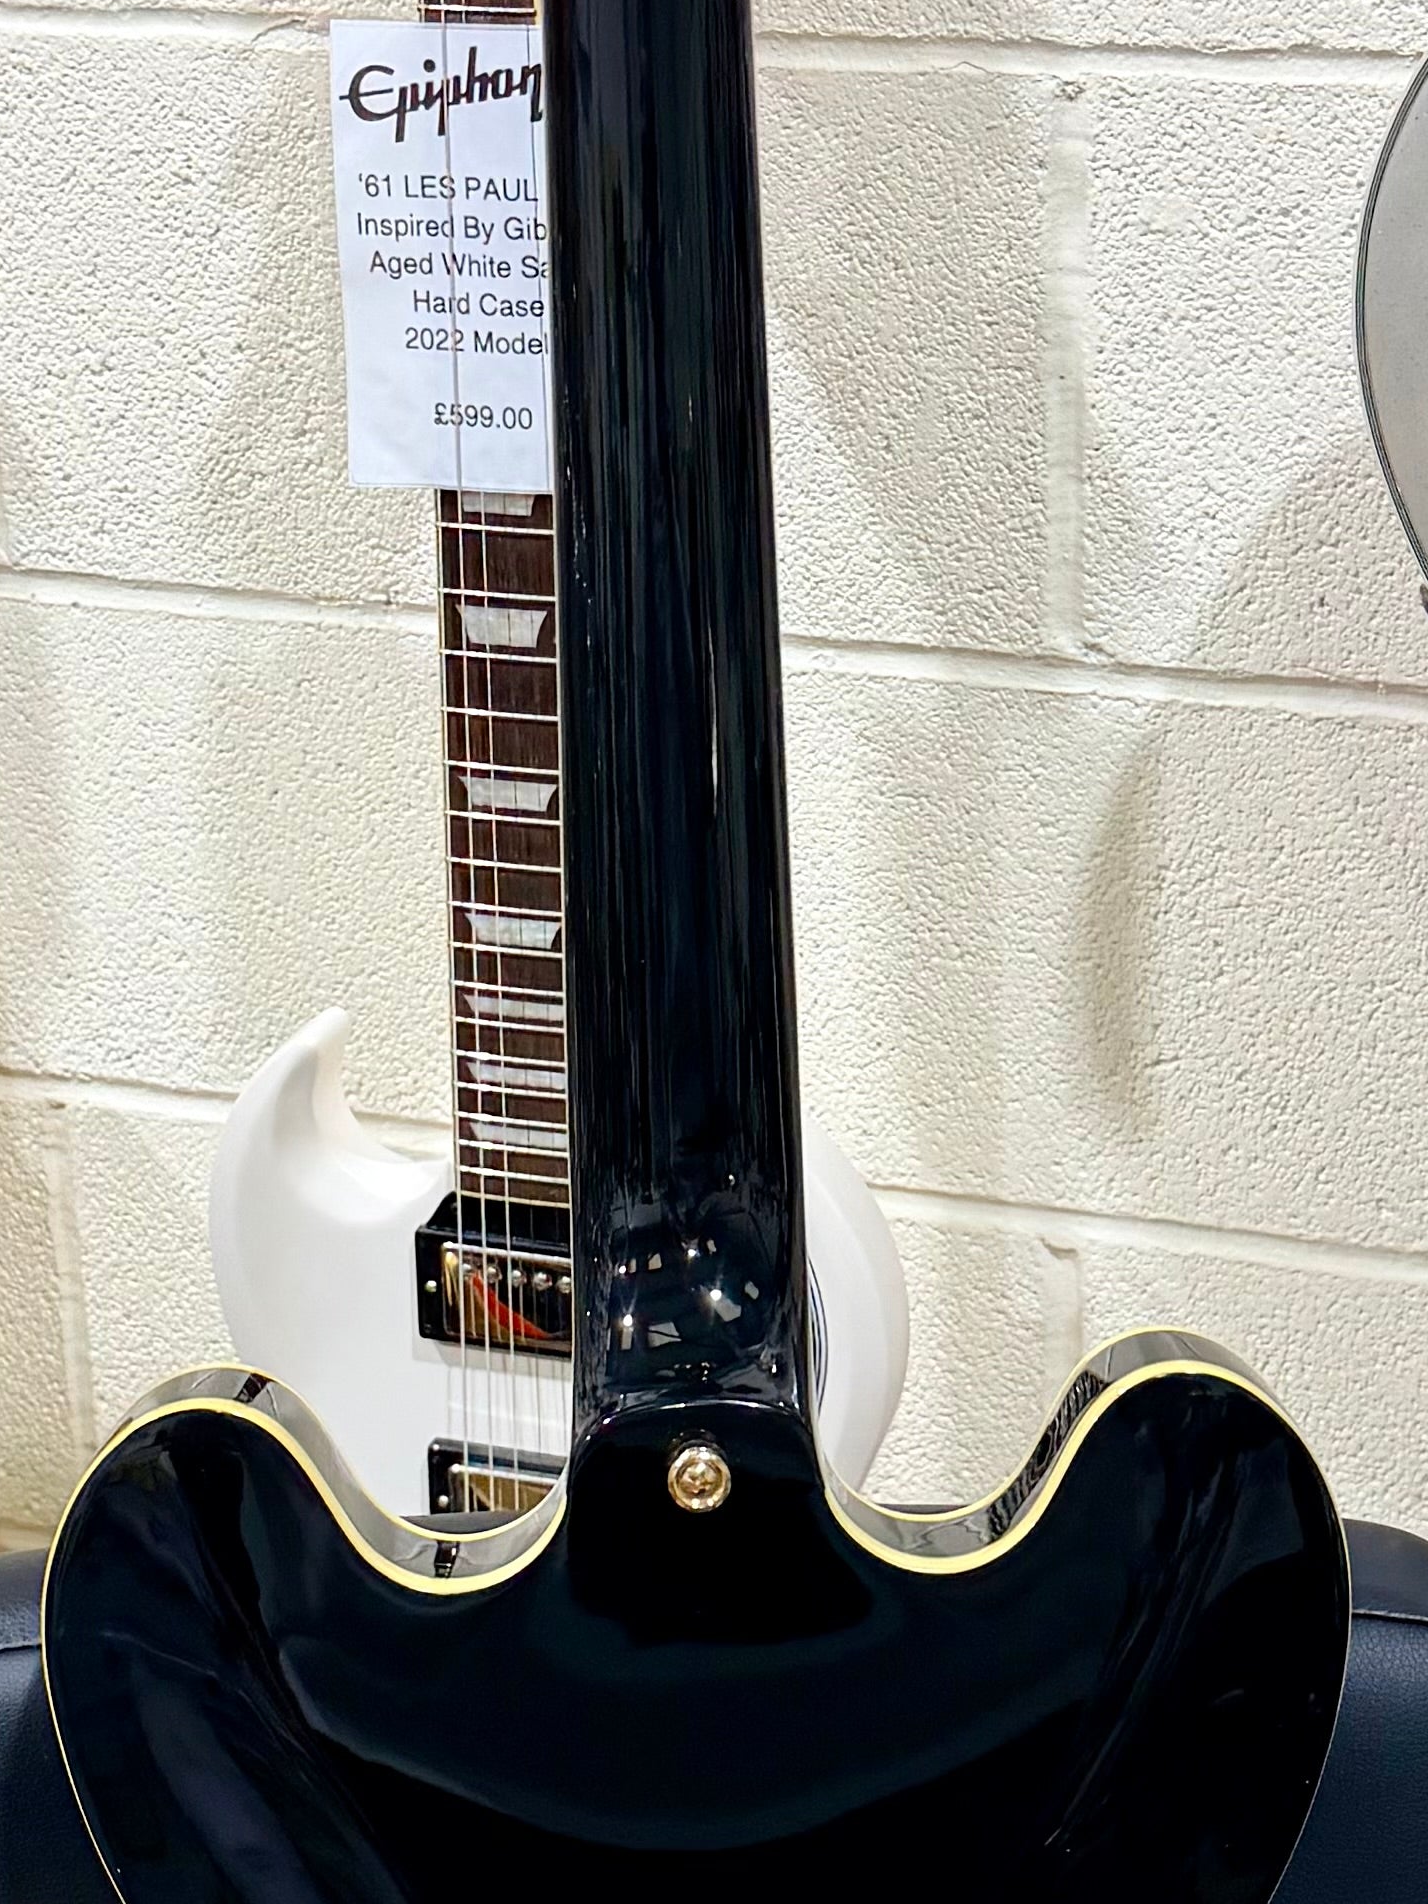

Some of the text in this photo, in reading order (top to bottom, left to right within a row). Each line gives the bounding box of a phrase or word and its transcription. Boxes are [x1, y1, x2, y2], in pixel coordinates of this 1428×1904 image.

[339, 46, 542, 143] Epiphon
[404, 175, 455, 200] LES
[465, 177, 538, 202] PAUL
[357, 213, 546, 245] Inspired By Gib
[370, 251, 433, 279] Aged
[442, 253, 511, 279] White
[413, 290, 544, 318] Hard Case
[405, 327, 548, 355] 2022 Model
[433, 403, 533, 430] £599.00
